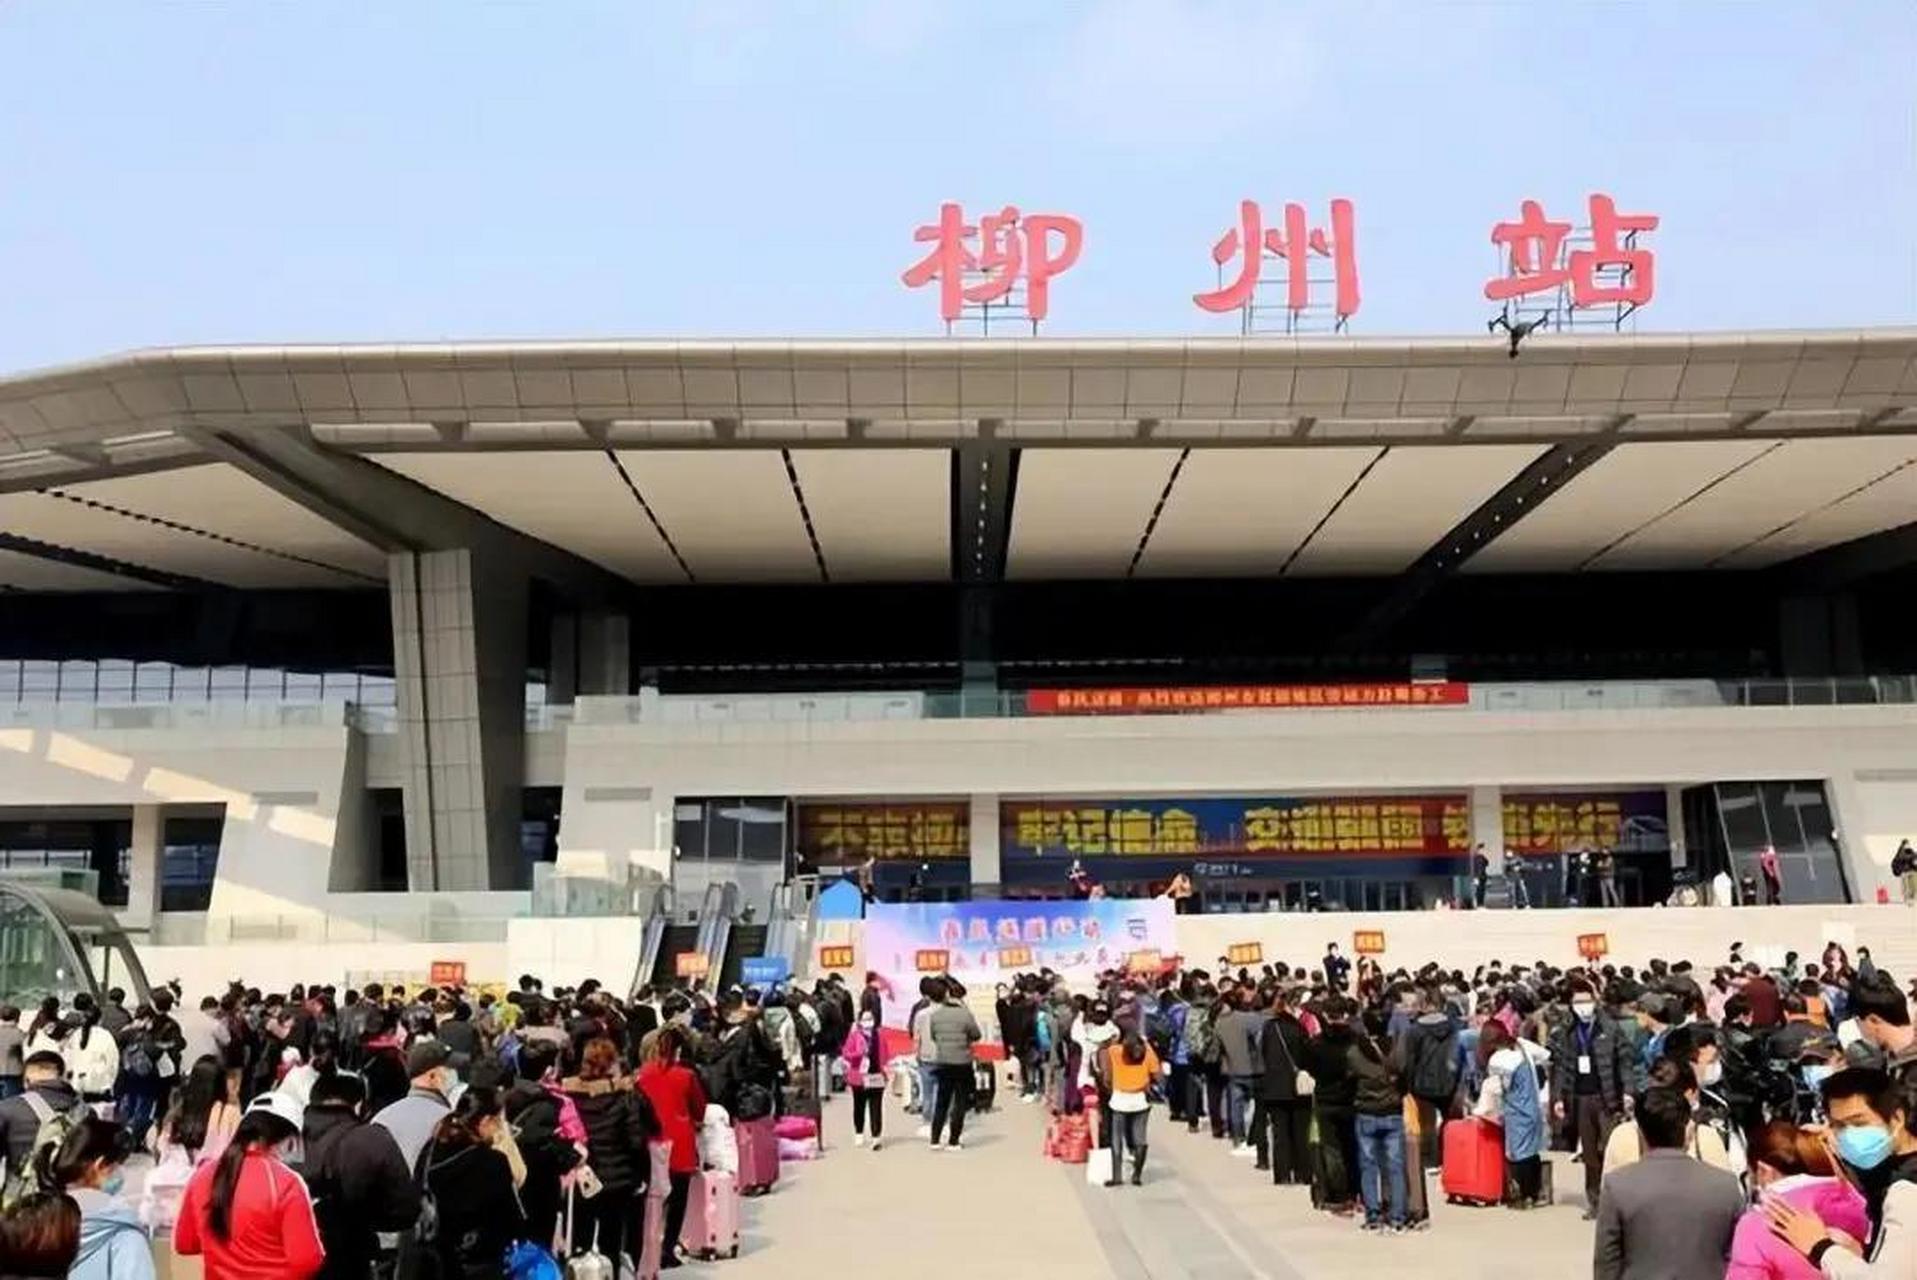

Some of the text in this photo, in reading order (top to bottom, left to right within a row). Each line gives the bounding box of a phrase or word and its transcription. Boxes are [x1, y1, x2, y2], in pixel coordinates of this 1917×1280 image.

[902, 194, 1659, 321] 柳州站
[817, 809, 972, 857] 不忘初
